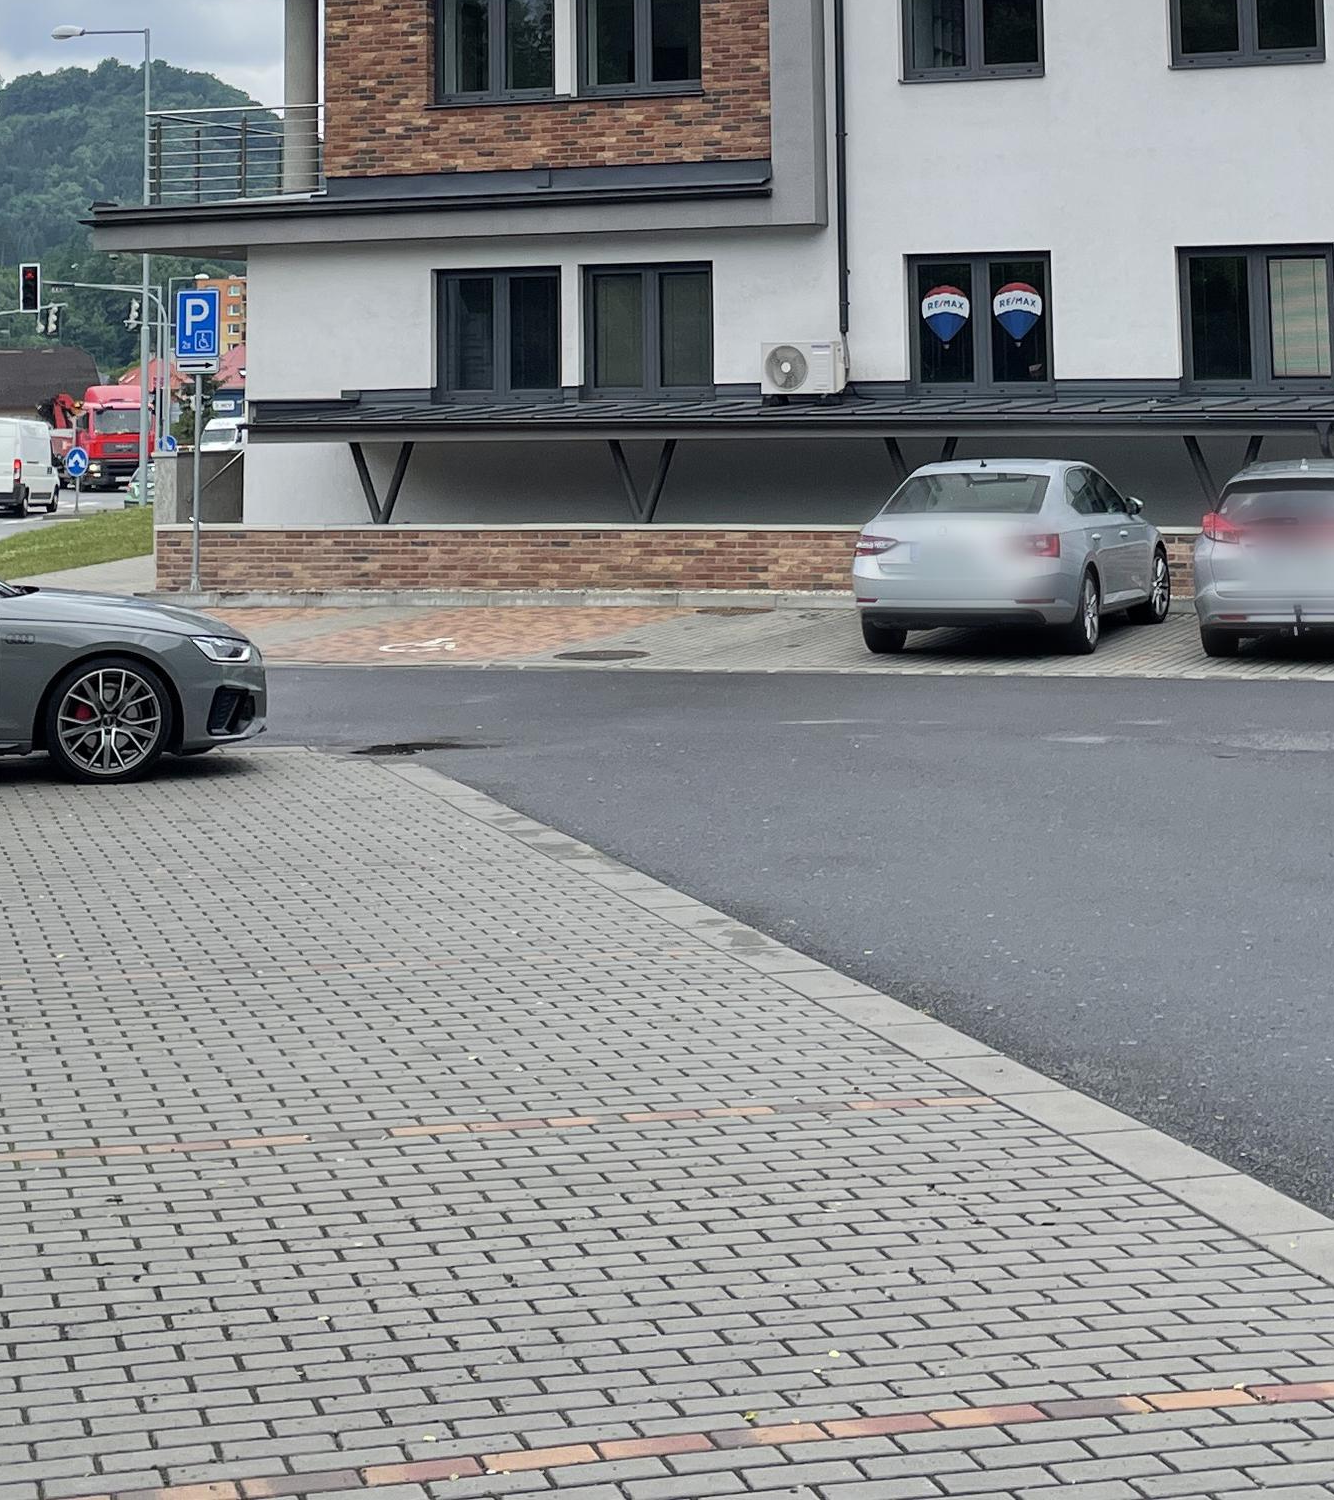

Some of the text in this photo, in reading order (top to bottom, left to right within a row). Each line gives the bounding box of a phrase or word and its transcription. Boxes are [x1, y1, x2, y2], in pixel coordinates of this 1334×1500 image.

[927, 299, 964, 311] RE/MAX
[999, 296, 1037, 308] RE/MAX
[185, 298, 210, 337] P
